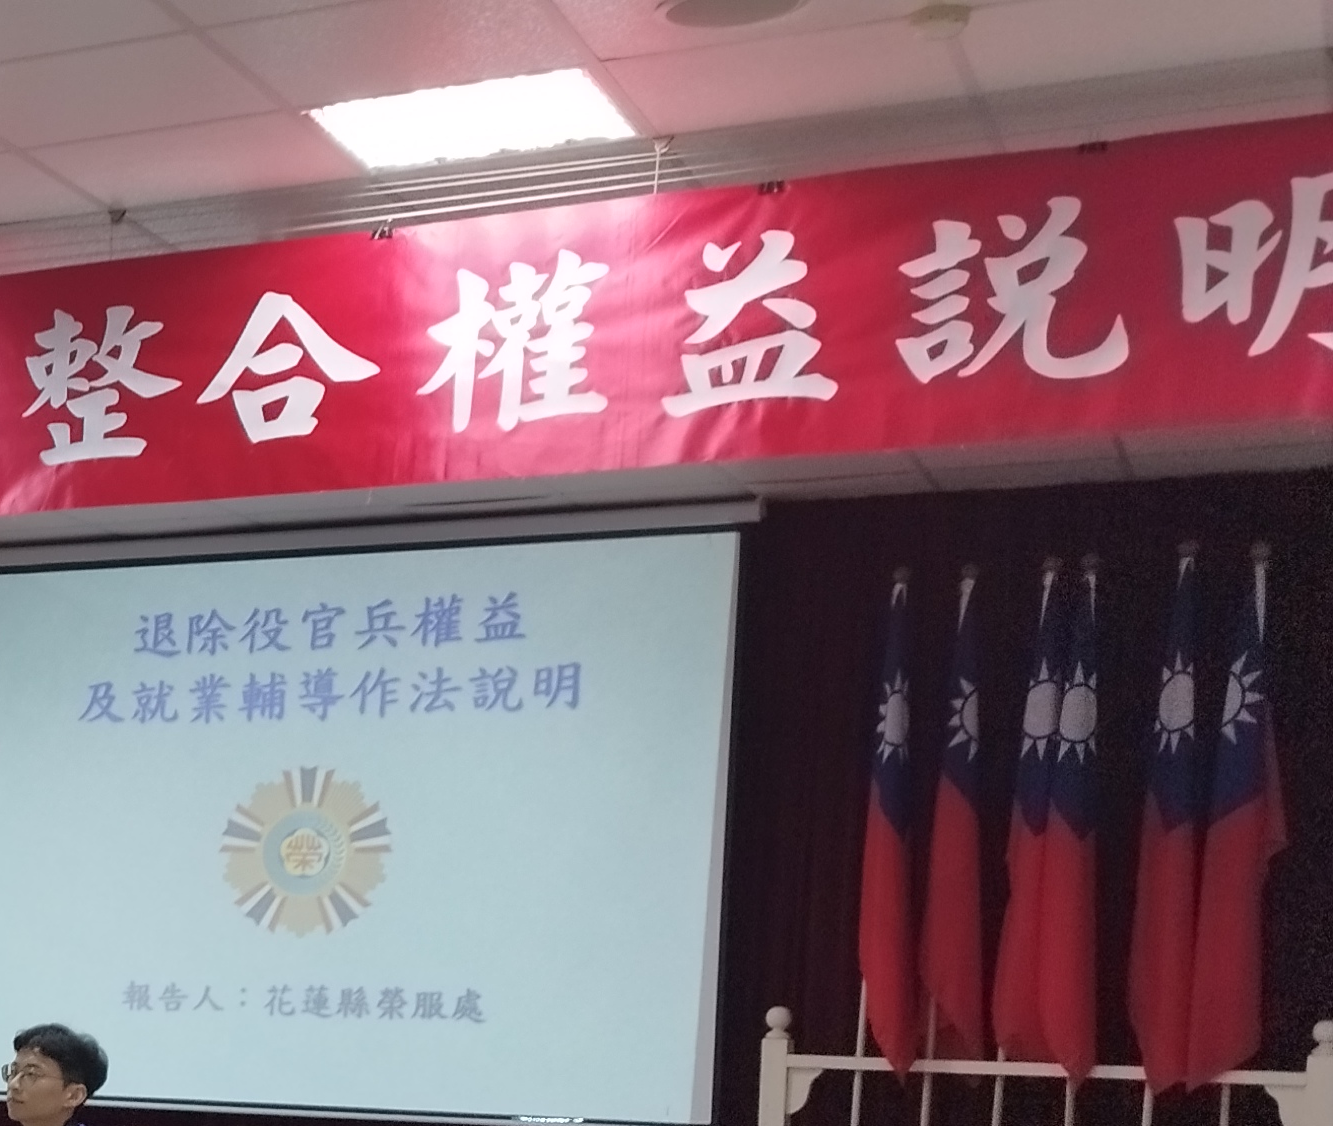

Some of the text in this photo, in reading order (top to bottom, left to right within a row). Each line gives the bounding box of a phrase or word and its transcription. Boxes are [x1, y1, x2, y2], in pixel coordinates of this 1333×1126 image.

[133, 592, 527, 658] 退除役官兵權益
[77, 661, 583, 725] 及就業輔導作法說明
[121, 979, 487, 1024] 報告人：花蓮縣榮服處
